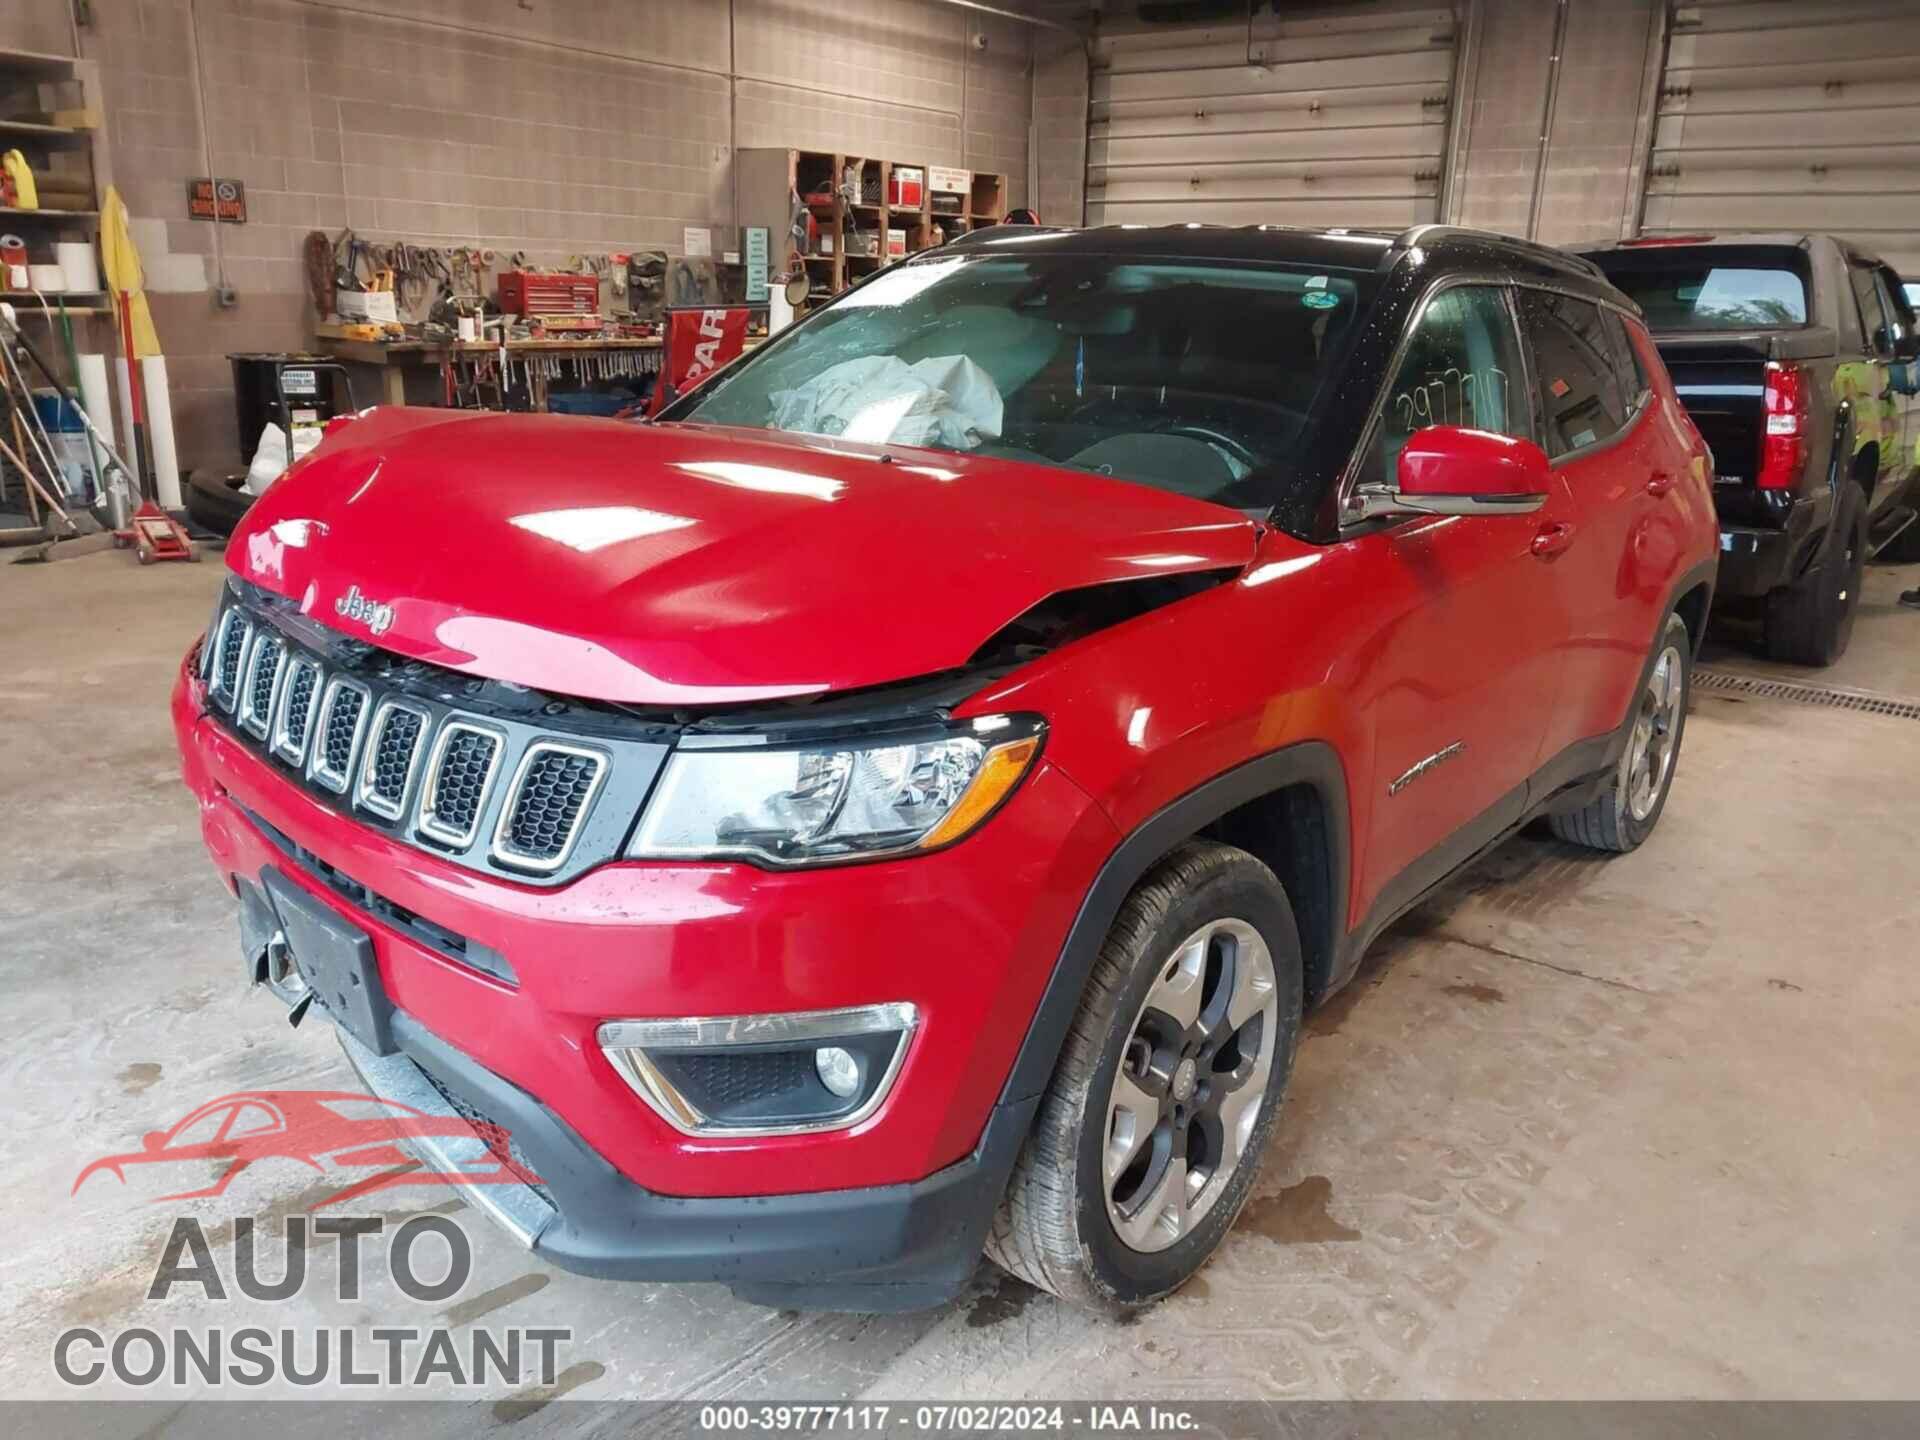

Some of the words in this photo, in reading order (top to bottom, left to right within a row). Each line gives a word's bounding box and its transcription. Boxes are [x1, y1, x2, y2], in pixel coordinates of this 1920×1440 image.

[197, 183, 214, 199] NO
[191, 200, 242, 217] SMOKING
[335, 585, 395, 636] Jeep
